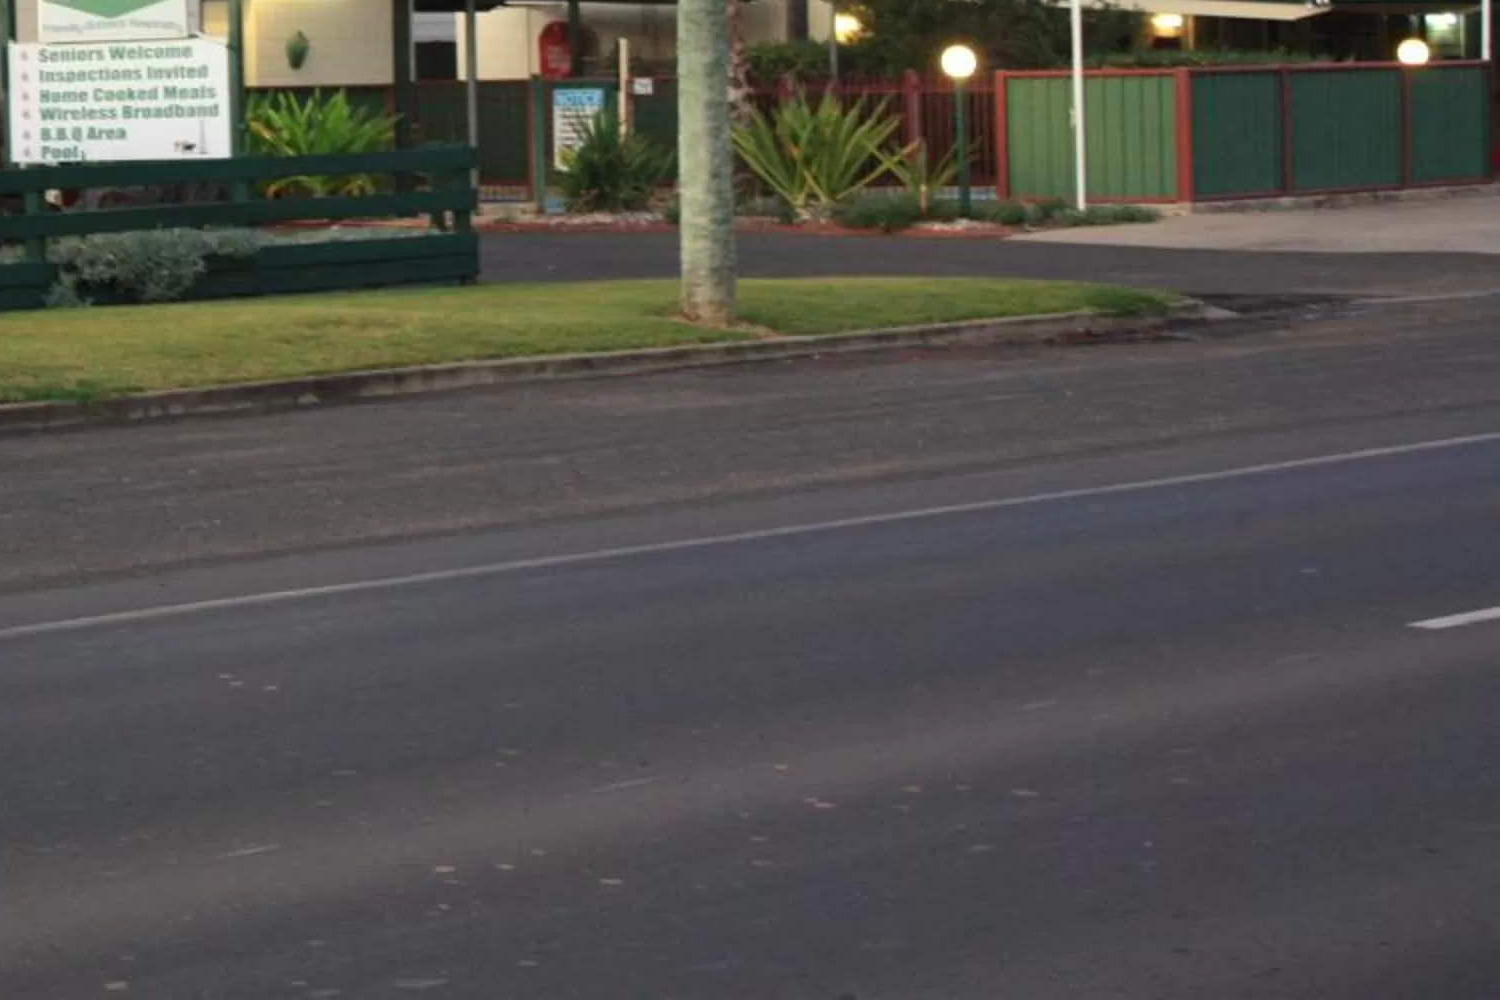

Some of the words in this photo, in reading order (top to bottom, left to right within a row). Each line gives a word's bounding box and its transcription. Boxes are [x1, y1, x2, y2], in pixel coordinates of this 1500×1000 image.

[38, 47, 105, 62] Seniors
[108, 45, 193, 61] Welcome
[39, 67, 142, 83] Inspections
[147, 64, 209, 81] Invited
[39, 89, 89, 103] Home
[92, 86, 159, 101] Cooked
[163, 84, 217, 100] Meals
[40, 106, 117, 121] Wireless
[122, 103, 219, 119] Broadband
[87, 125, 127, 140] Area
